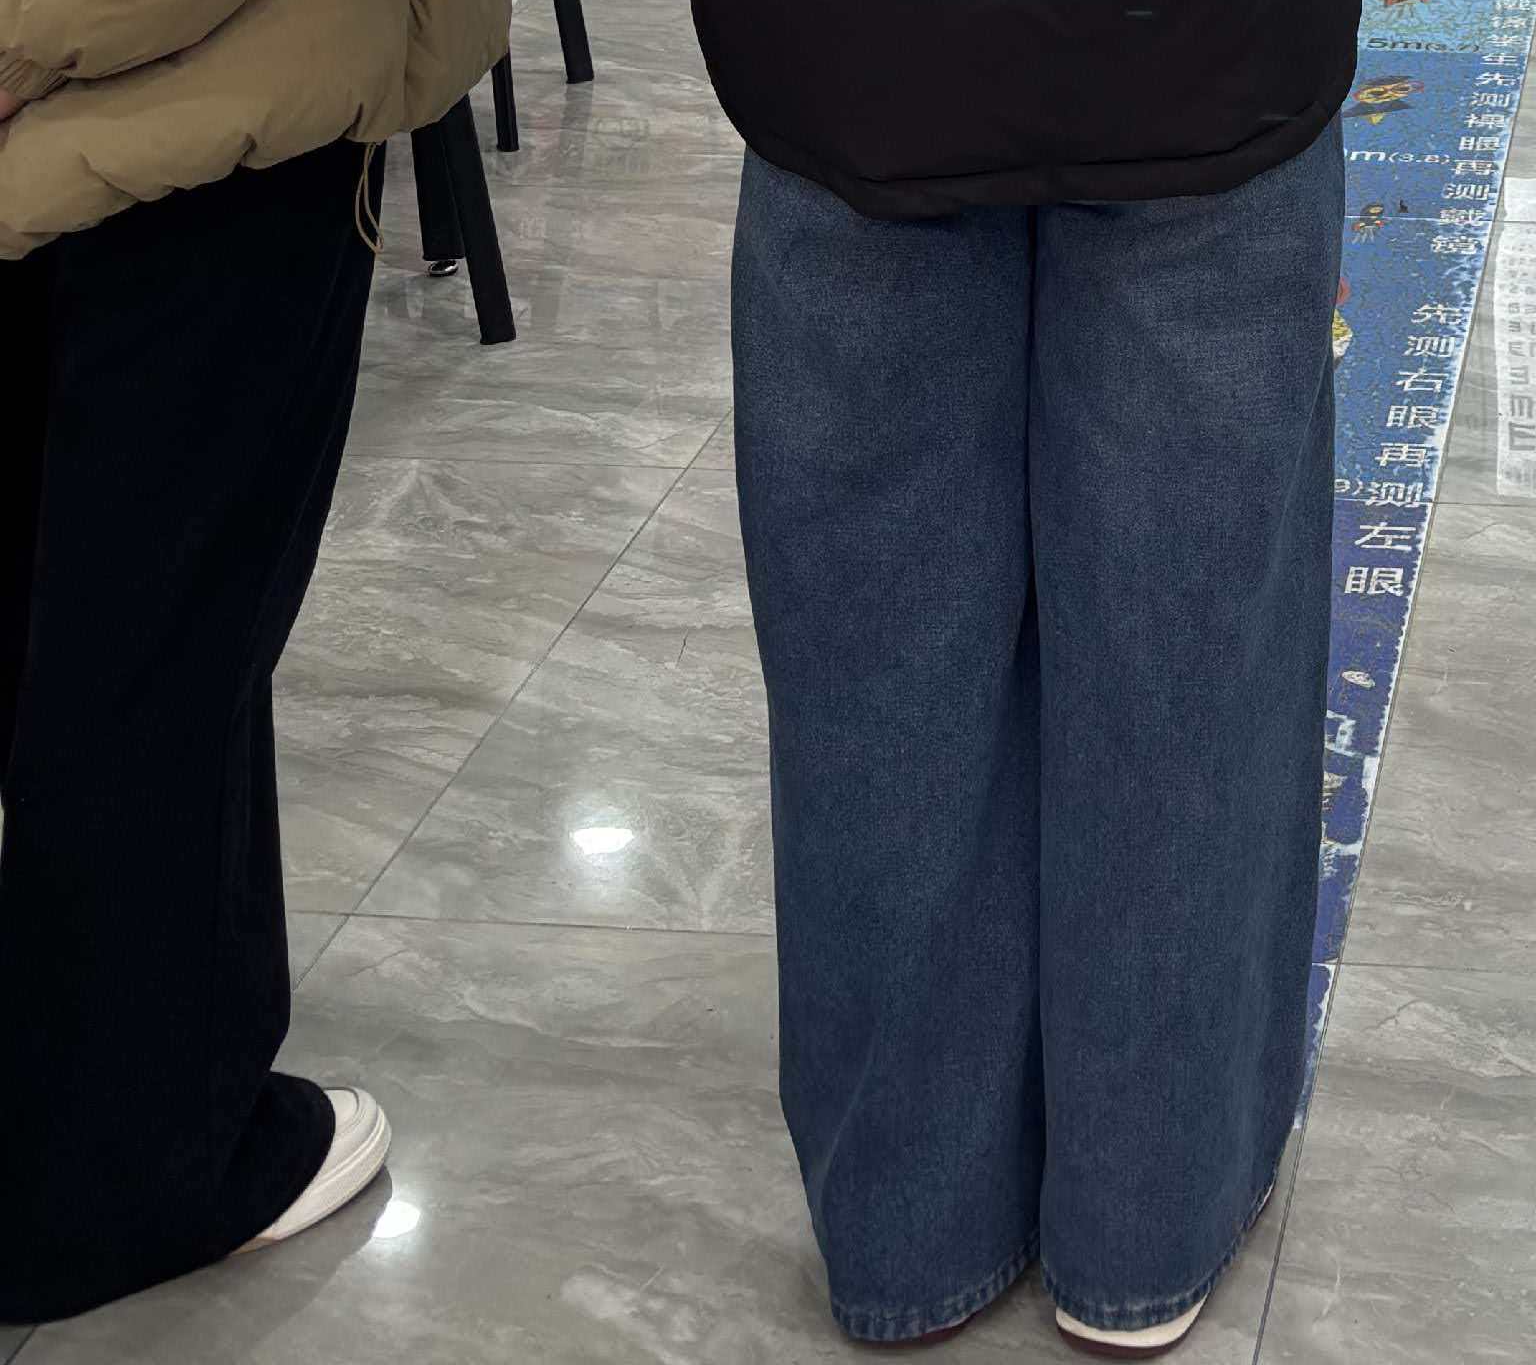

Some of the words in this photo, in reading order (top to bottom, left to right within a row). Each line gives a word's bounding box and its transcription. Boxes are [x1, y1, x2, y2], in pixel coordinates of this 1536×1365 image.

[1344, 303, 1464, 596] 先测右眼再测左眼
